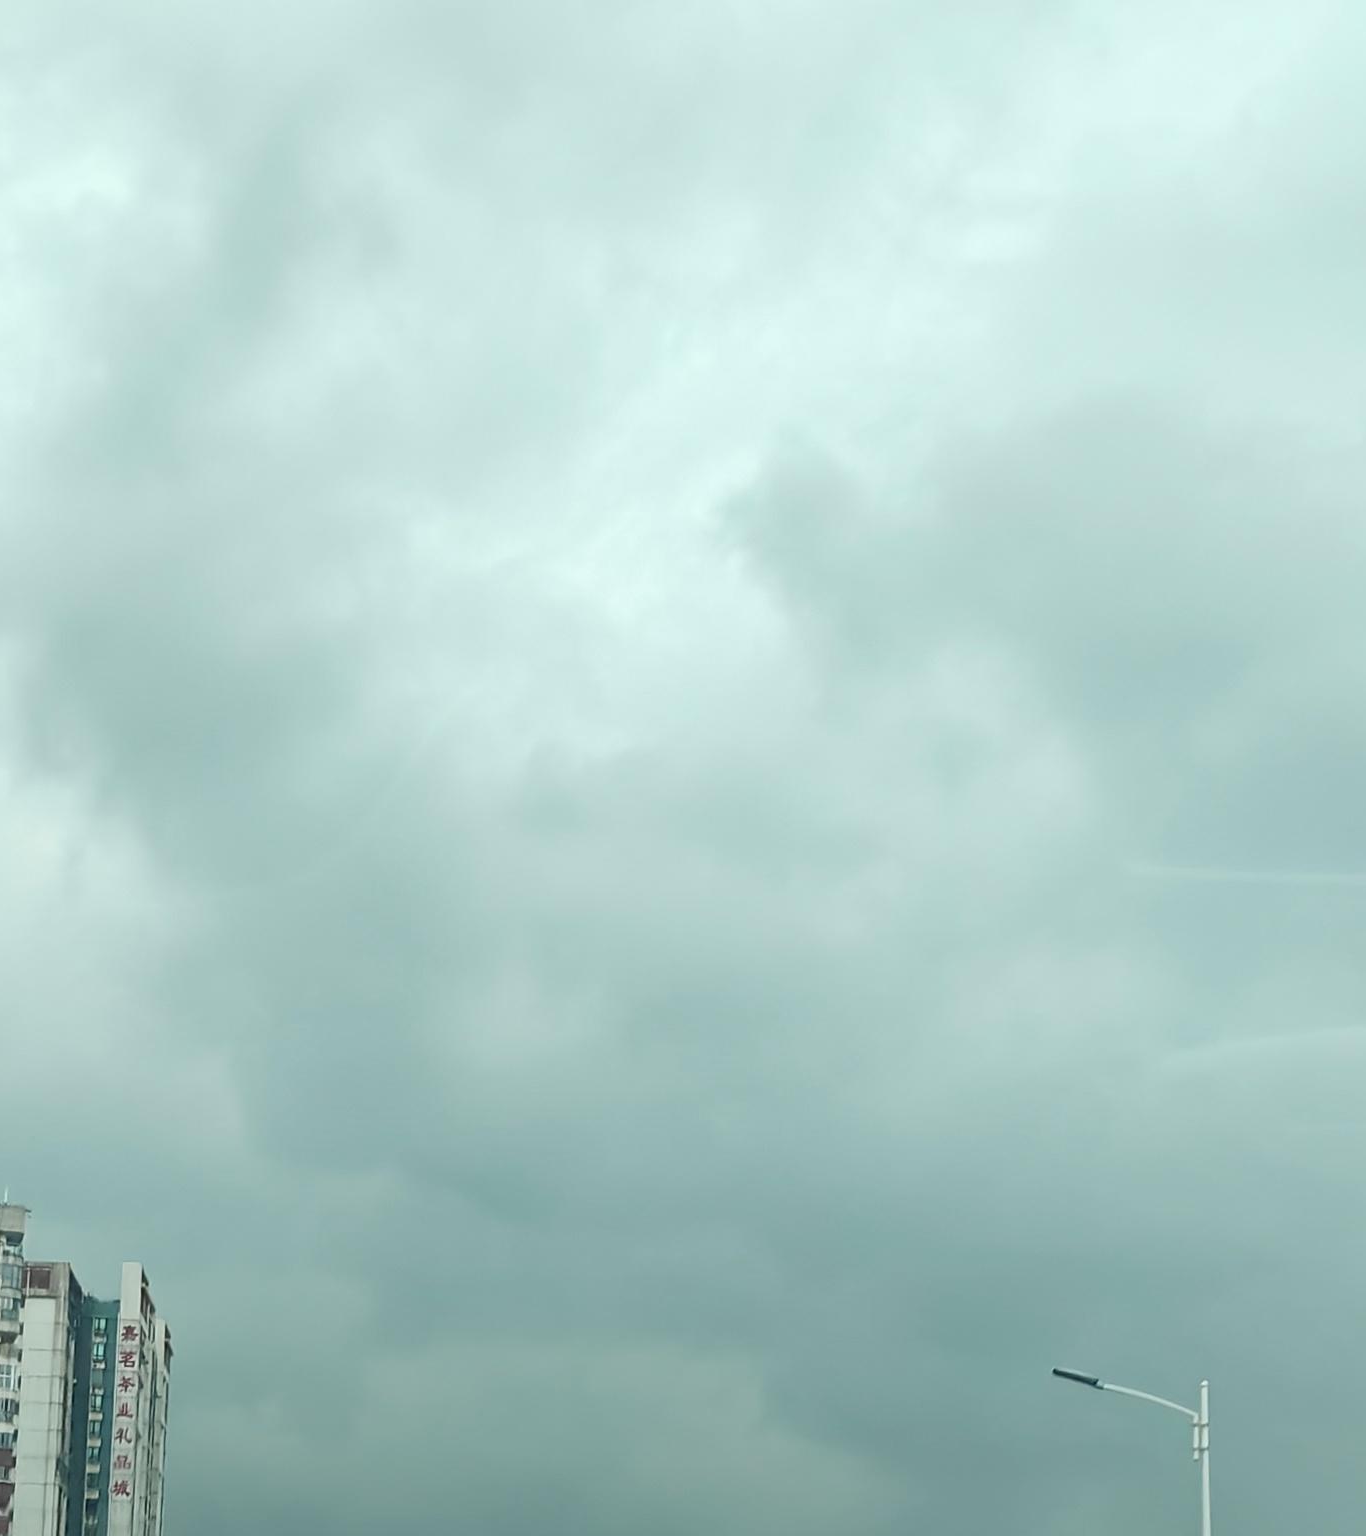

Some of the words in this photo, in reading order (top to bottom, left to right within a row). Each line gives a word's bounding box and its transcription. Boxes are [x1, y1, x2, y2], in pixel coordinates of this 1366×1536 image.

[112, 1325, 139, 1497] 嘉茗茶业礼品城
